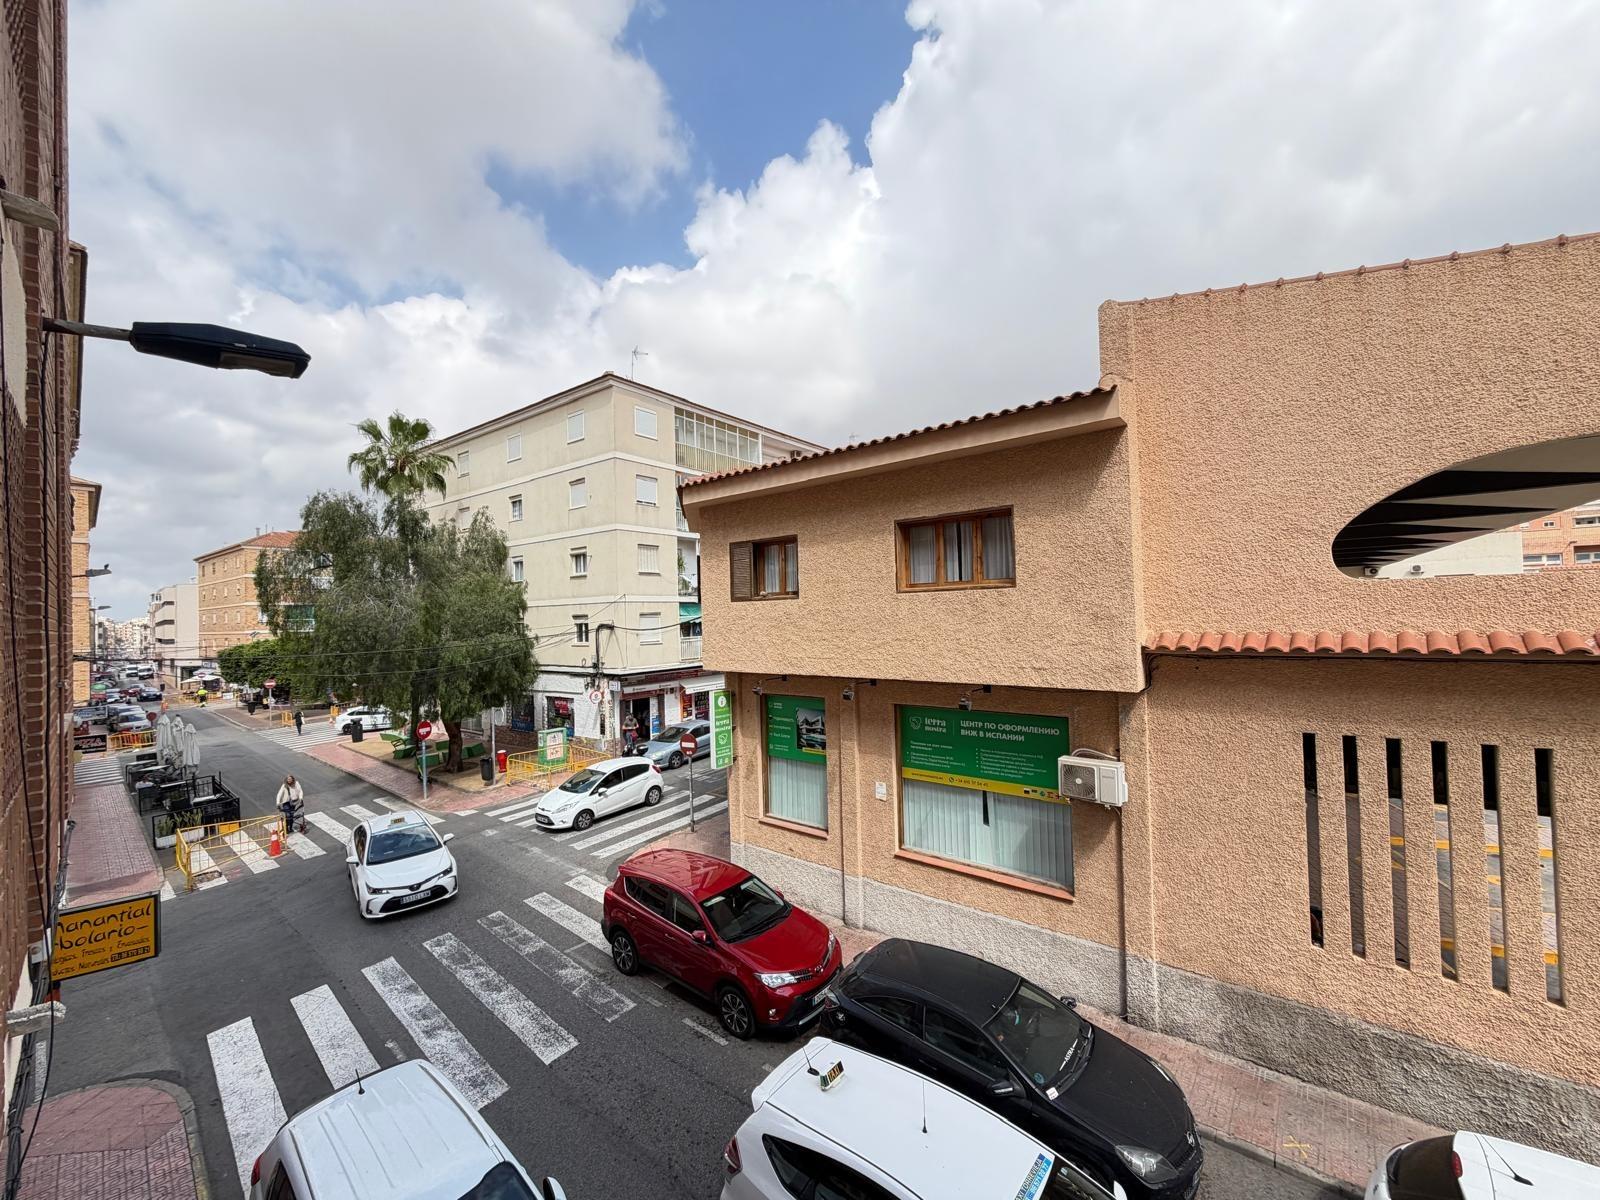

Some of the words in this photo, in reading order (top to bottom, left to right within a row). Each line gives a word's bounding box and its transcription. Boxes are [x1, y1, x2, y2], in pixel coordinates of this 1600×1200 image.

[960, 729, 978, 738] ВНЖ
[979, 730, 984, 738] В
[986, 731, 1025, 742] ИСПАНИИ
[961, 720, 983, 729] ЦЕНТР
[984, 722, 996, 730] ПО
[998, 723, 1060, 736] ОФОРМЛЕНИЮ
[1064, 1047, 1075, 1062] ASTRA
